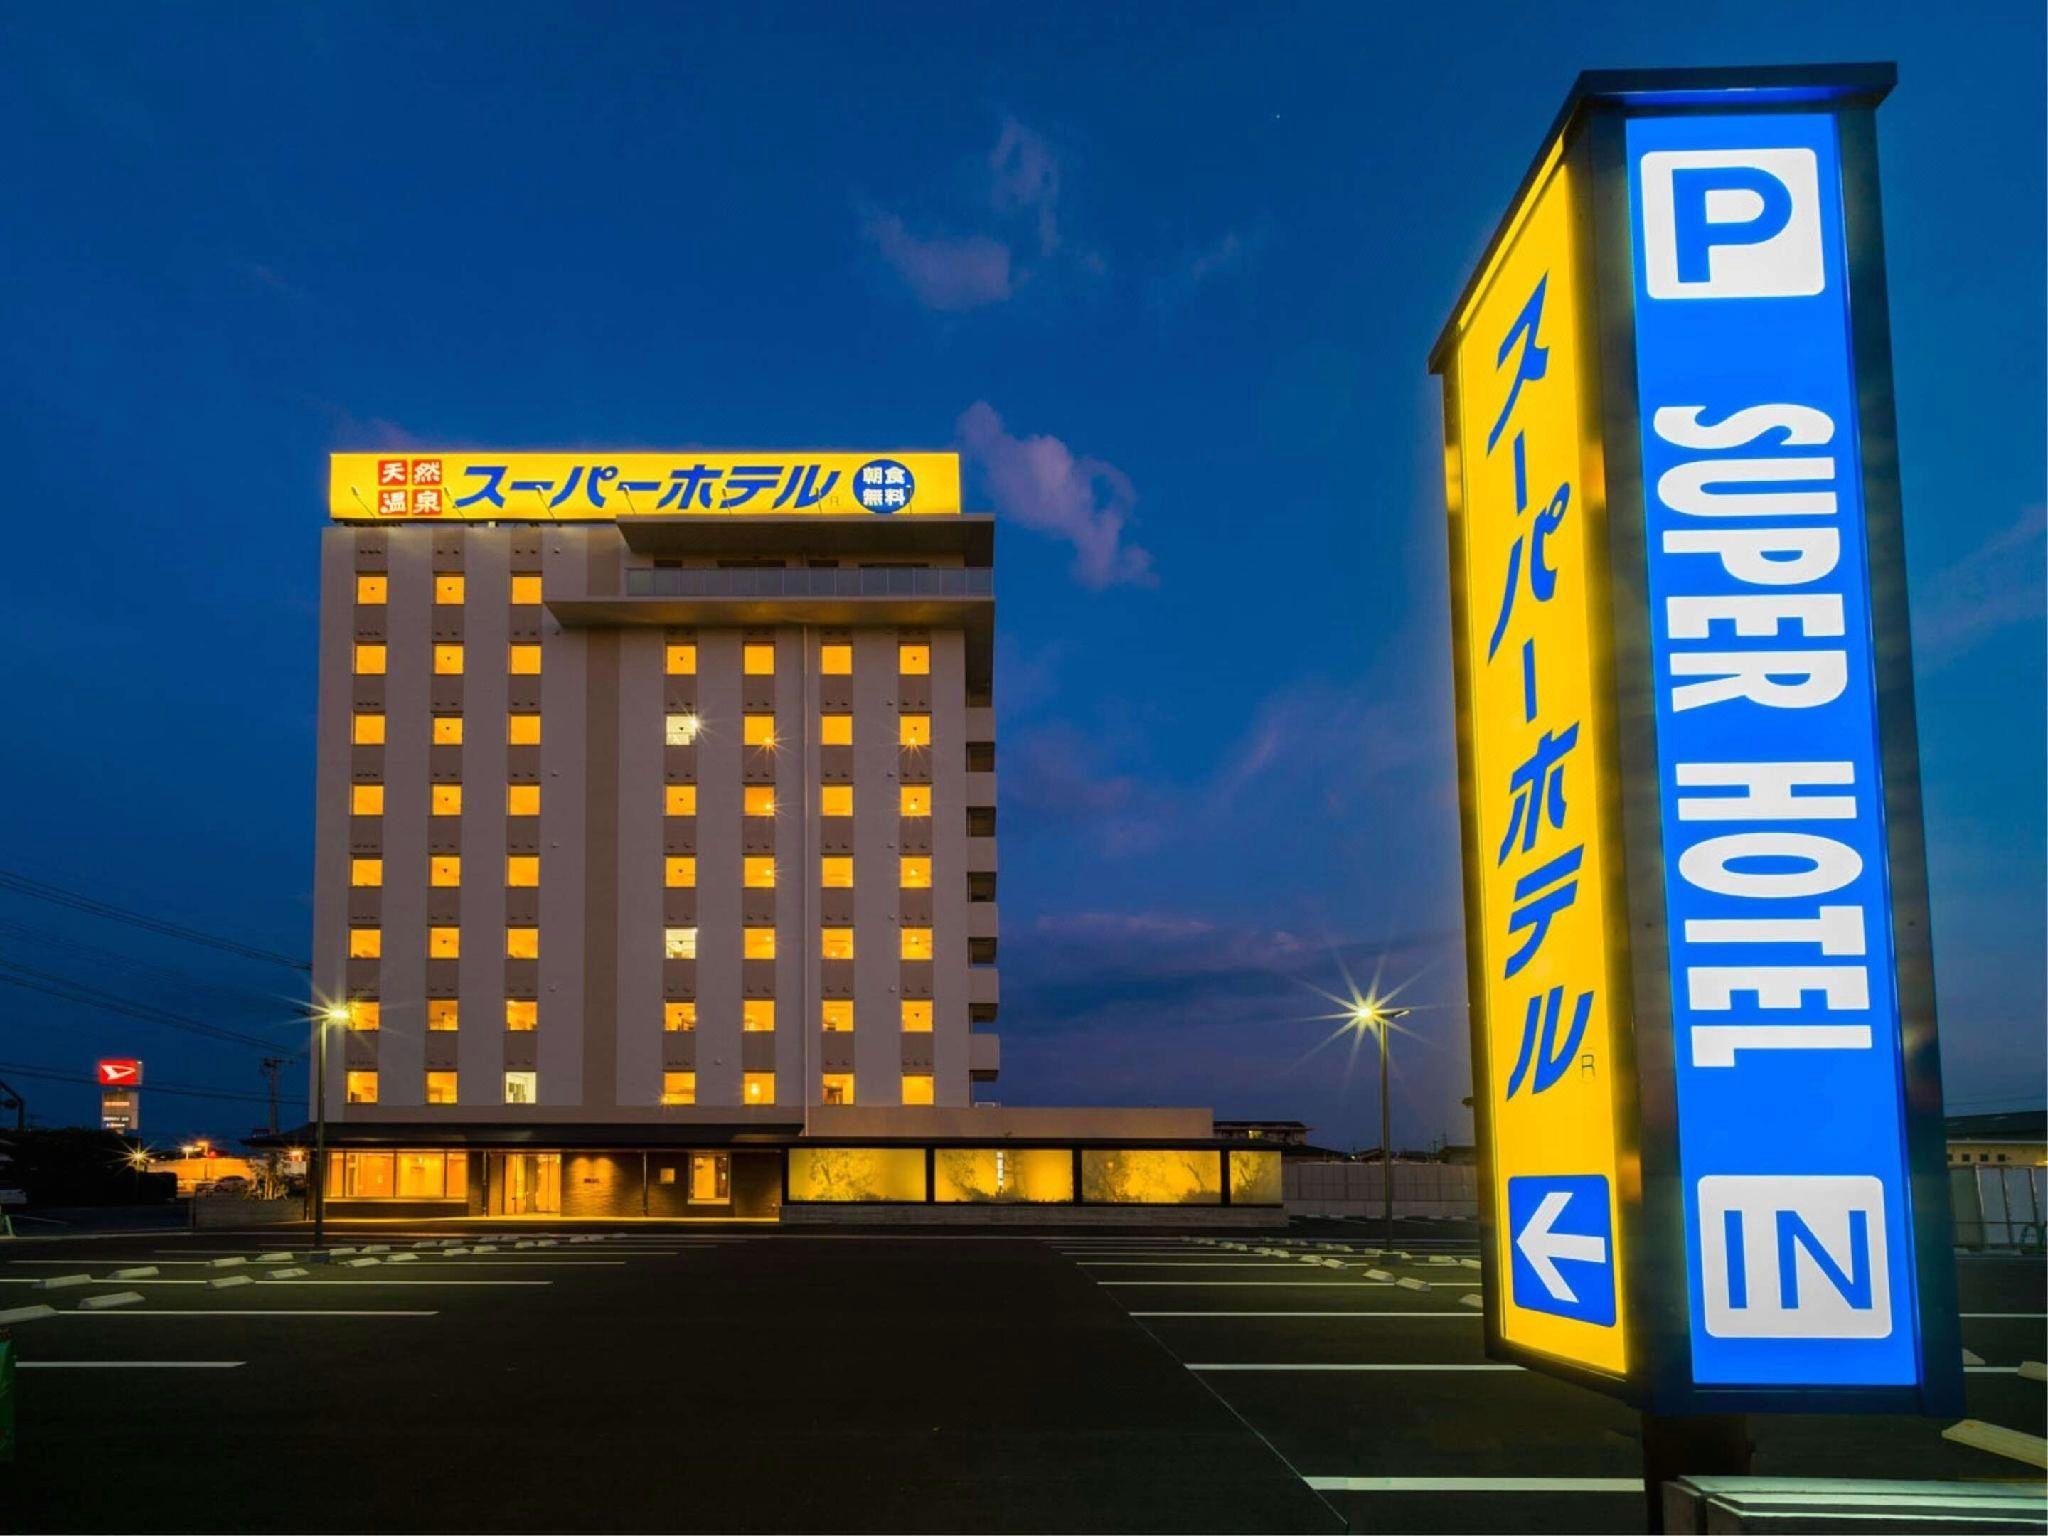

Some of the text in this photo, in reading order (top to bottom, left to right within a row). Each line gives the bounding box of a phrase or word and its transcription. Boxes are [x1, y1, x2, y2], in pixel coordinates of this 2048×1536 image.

[1671, 165, 1793, 283] P
[380, 491, 441, 514] 温泉
[381, 461, 441, 485] 天然
[454, 464, 842, 509] スーパーホテル
[1486, 269, 1594, 1101] スーパーホテル
[1653, 403, 1872, 1067] SUPER HOTEL
[1723, 1209, 1873, 1310] IN
